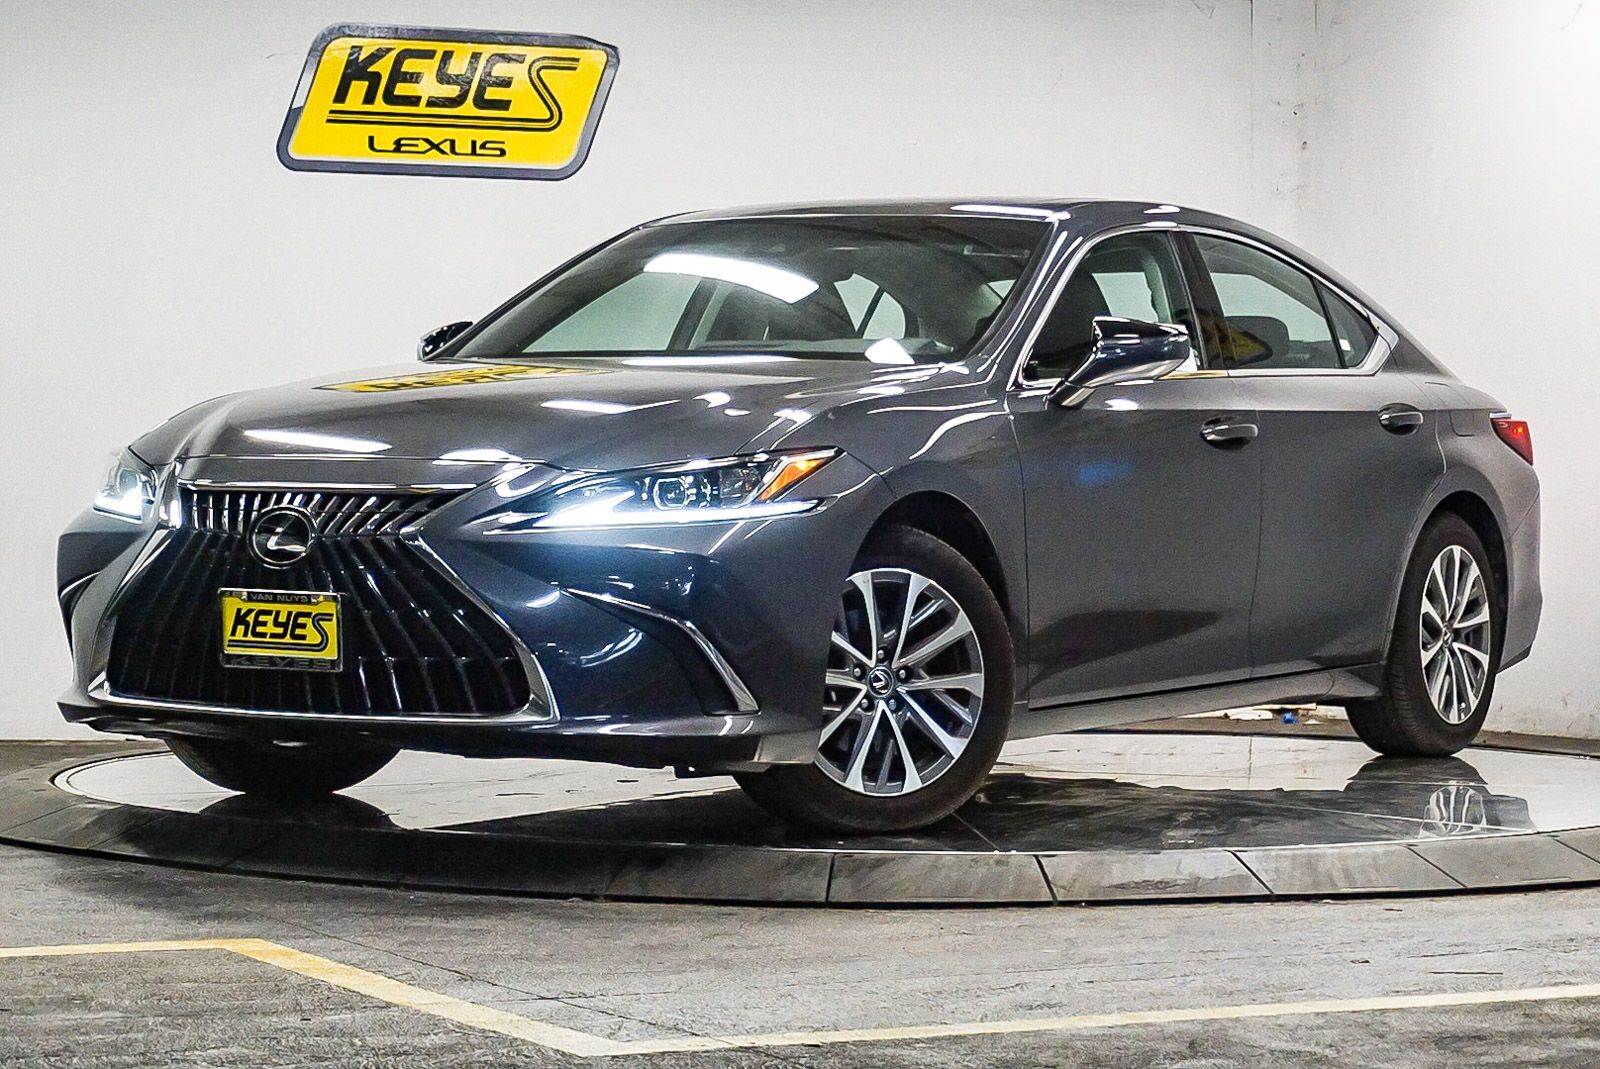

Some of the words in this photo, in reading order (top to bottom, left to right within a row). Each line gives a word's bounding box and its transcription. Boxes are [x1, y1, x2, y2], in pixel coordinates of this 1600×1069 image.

[326, 45, 580, 132] KEYES
[368, 135, 507, 158] LEXUS
[250, 593, 273, 601] VAN
[276, 594, 309, 603] NUYS
[227, 607, 334, 653] KEYES
